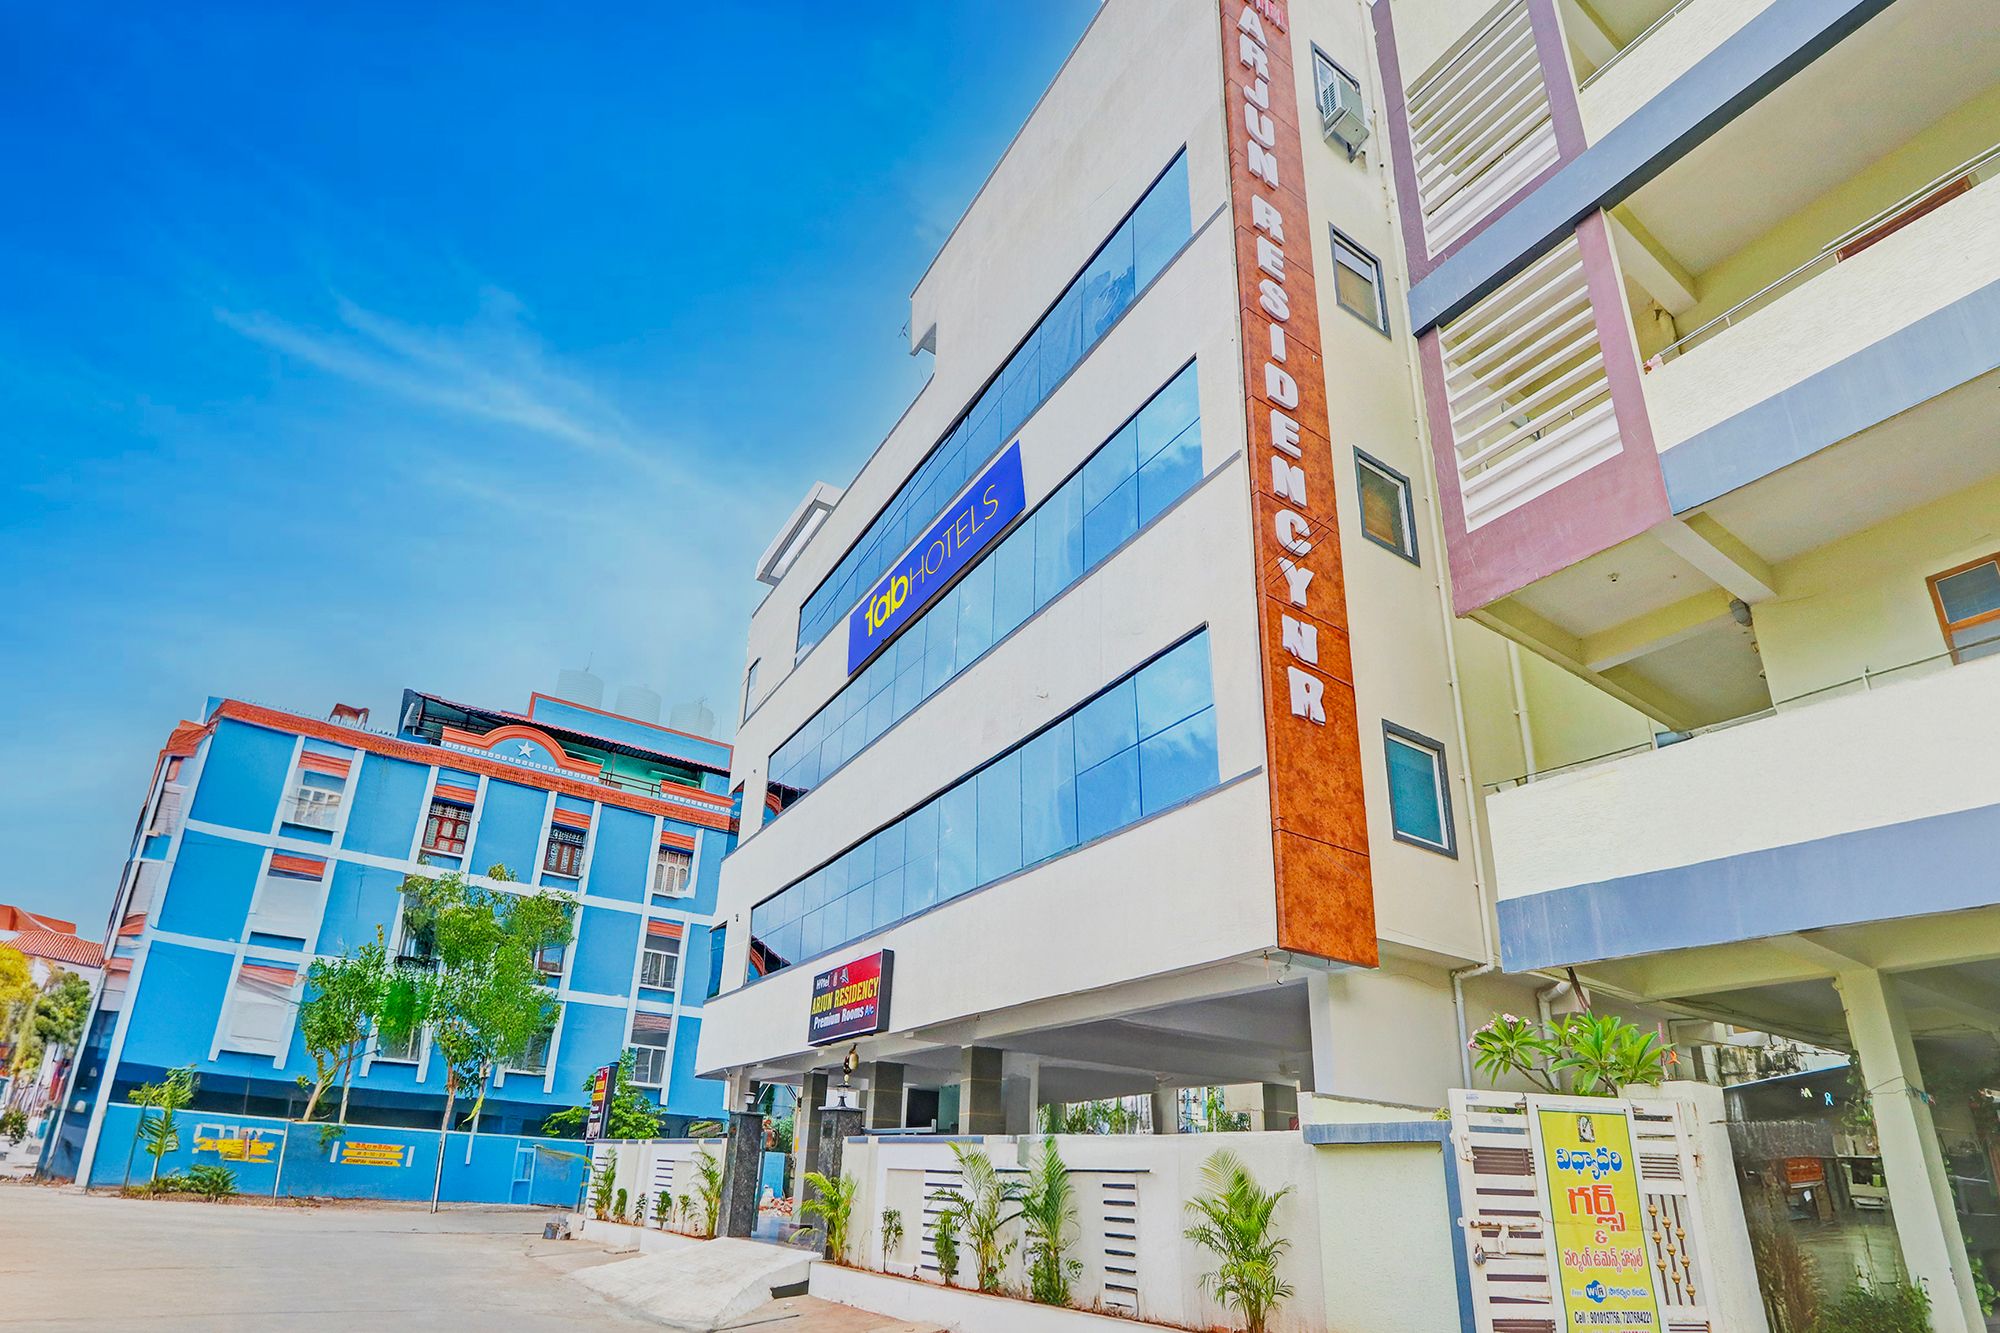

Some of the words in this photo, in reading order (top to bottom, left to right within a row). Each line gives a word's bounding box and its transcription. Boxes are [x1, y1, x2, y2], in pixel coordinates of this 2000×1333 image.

[1236, 5, 1279, 190] ARJUN
[1252, 194, 1315, 609] RESIDENCY
[834, 976, 880, 1008] RESIDENCY
[1595, 1229, 1608, 1244] &
